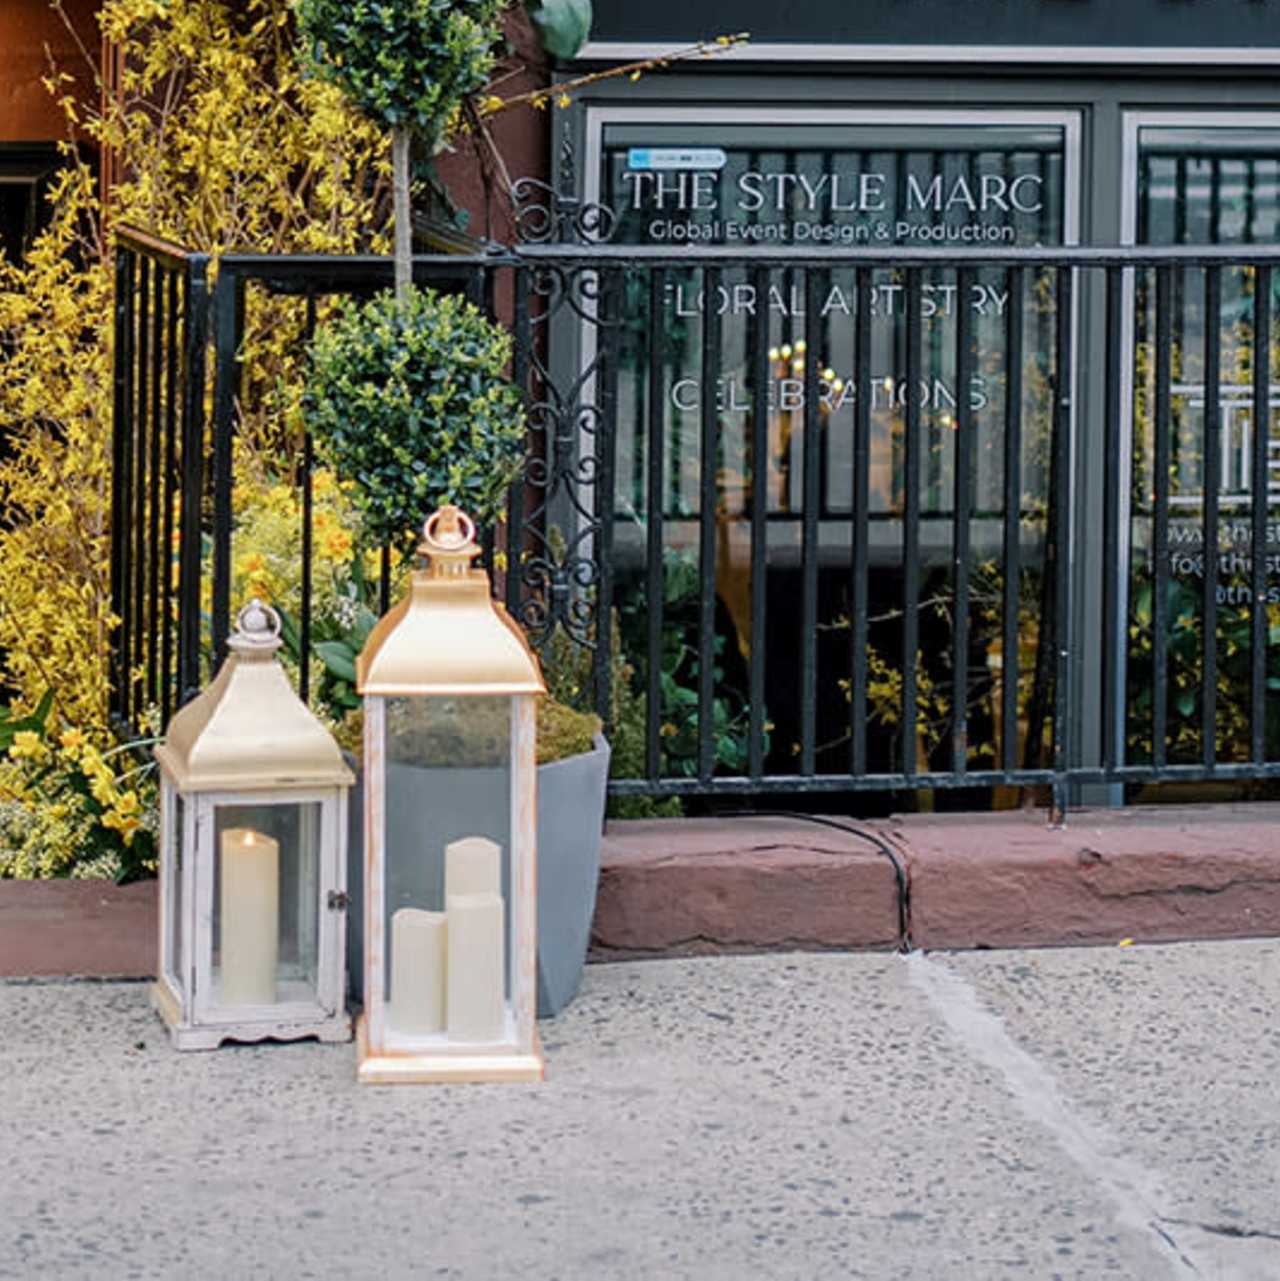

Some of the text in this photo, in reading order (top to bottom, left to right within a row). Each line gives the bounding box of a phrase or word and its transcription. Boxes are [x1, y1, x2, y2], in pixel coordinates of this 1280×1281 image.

[622, 171, 1045, 213] THE STYLE MARC
[649, 219, 1015, 245] Global Event Design & Production
